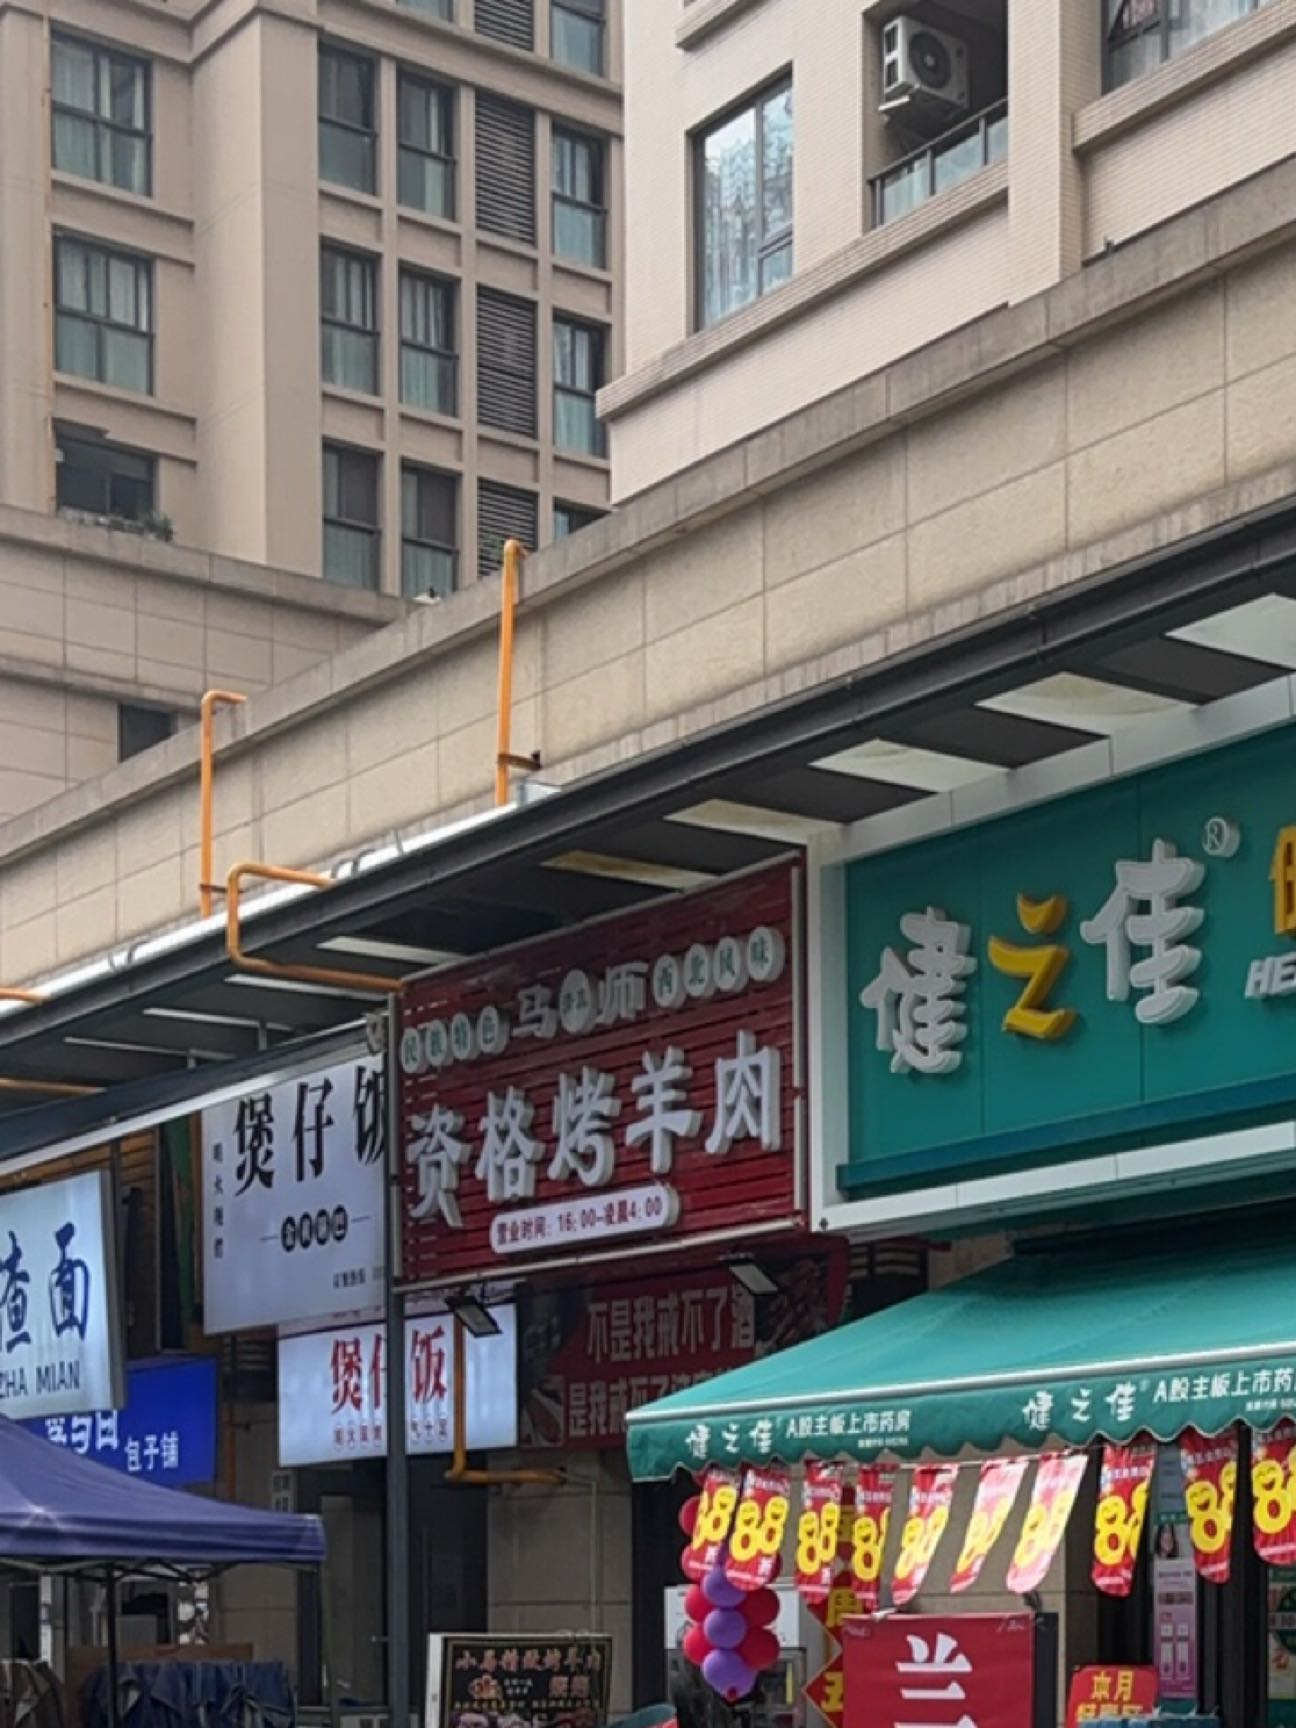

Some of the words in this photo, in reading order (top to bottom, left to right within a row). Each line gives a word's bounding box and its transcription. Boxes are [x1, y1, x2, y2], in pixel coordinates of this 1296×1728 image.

[860, 837, 1207, 1076] 健之佳
[405, 1028, 783, 1228] 资格烤羊肉
[35, 1359, 81, 1392] MIAN
[785, 1408, 912, 1439] A股主板上市药房
[1022, 1380, 1138, 1430] 健之佳
[124, 1430, 180, 1472] 包子铺
[730, 1495, 789, 1562] 88
[796, 1502, 841, 1574] 88
